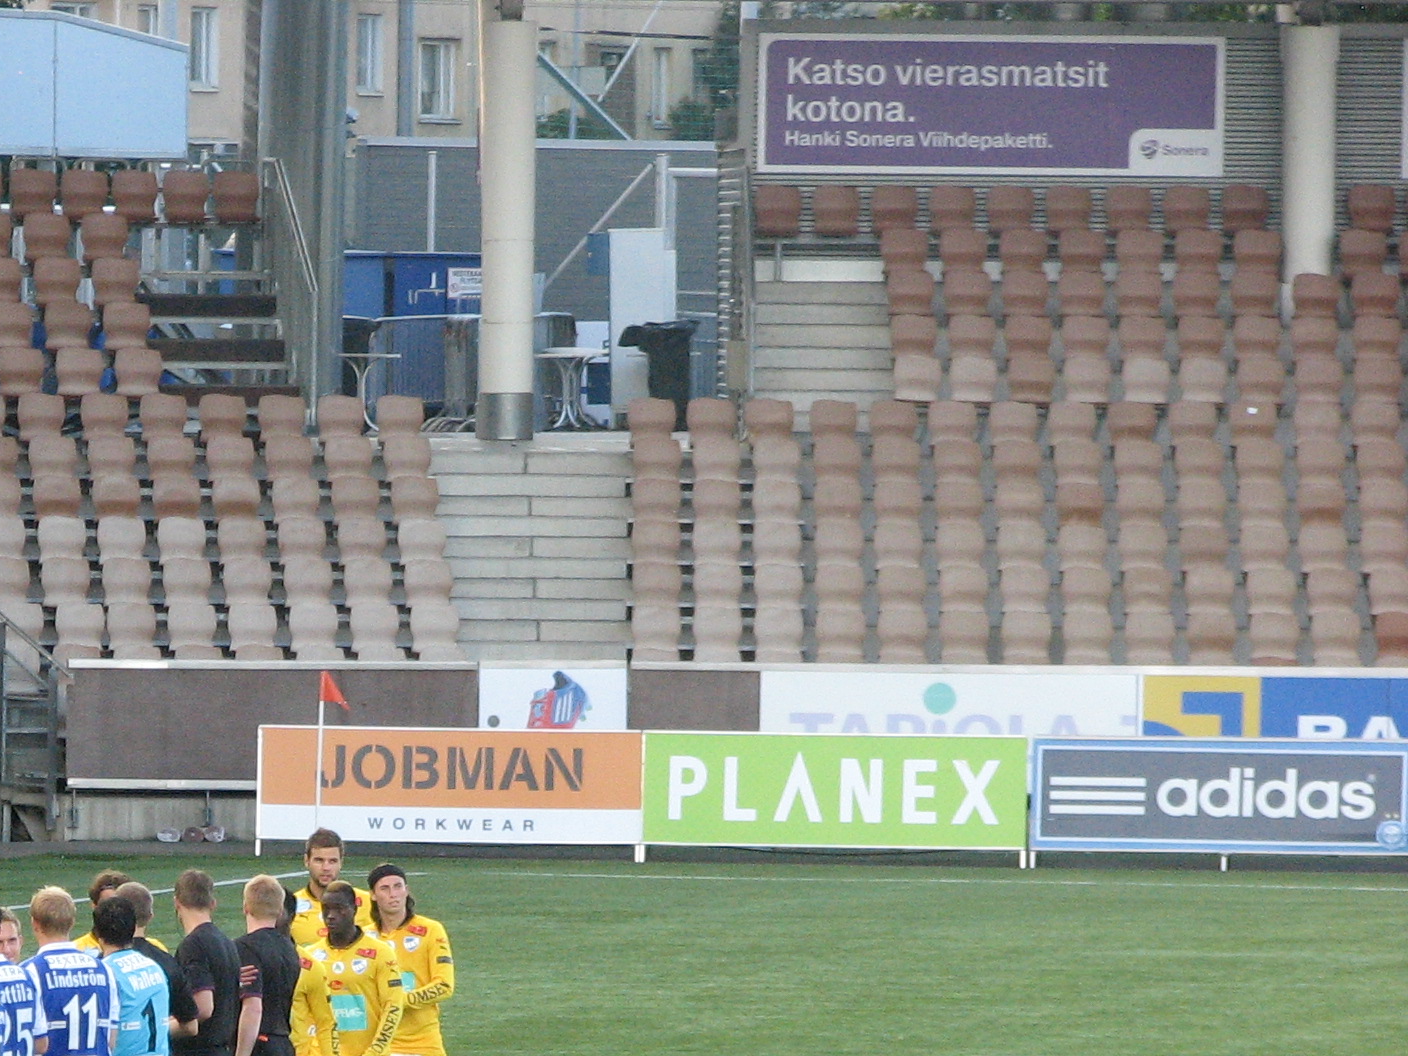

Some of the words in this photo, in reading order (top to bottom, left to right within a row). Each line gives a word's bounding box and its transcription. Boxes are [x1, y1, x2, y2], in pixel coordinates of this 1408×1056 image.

[787, 57, 886, 86] Katso
[895, 59, 1109, 89] vierasmatsit
[787, 94, 916, 123] kotona.
[785, 130, 842, 147] Hanki
[845, 131, 915, 149] Sonera
[918, 131, 1053, 152] Viihdepaketti.
[319, 744, 583, 791] JOBMAN
[668, 752, 1001, 825] PLANEX
[1156, 767, 1376, 820] adidas
[367, 816, 536, 832] WORKWEAR
[46, 968, 107, 990] Lindström
[62, 992, 98, 1051] 11
[140, 998, 157, 1053] 1
